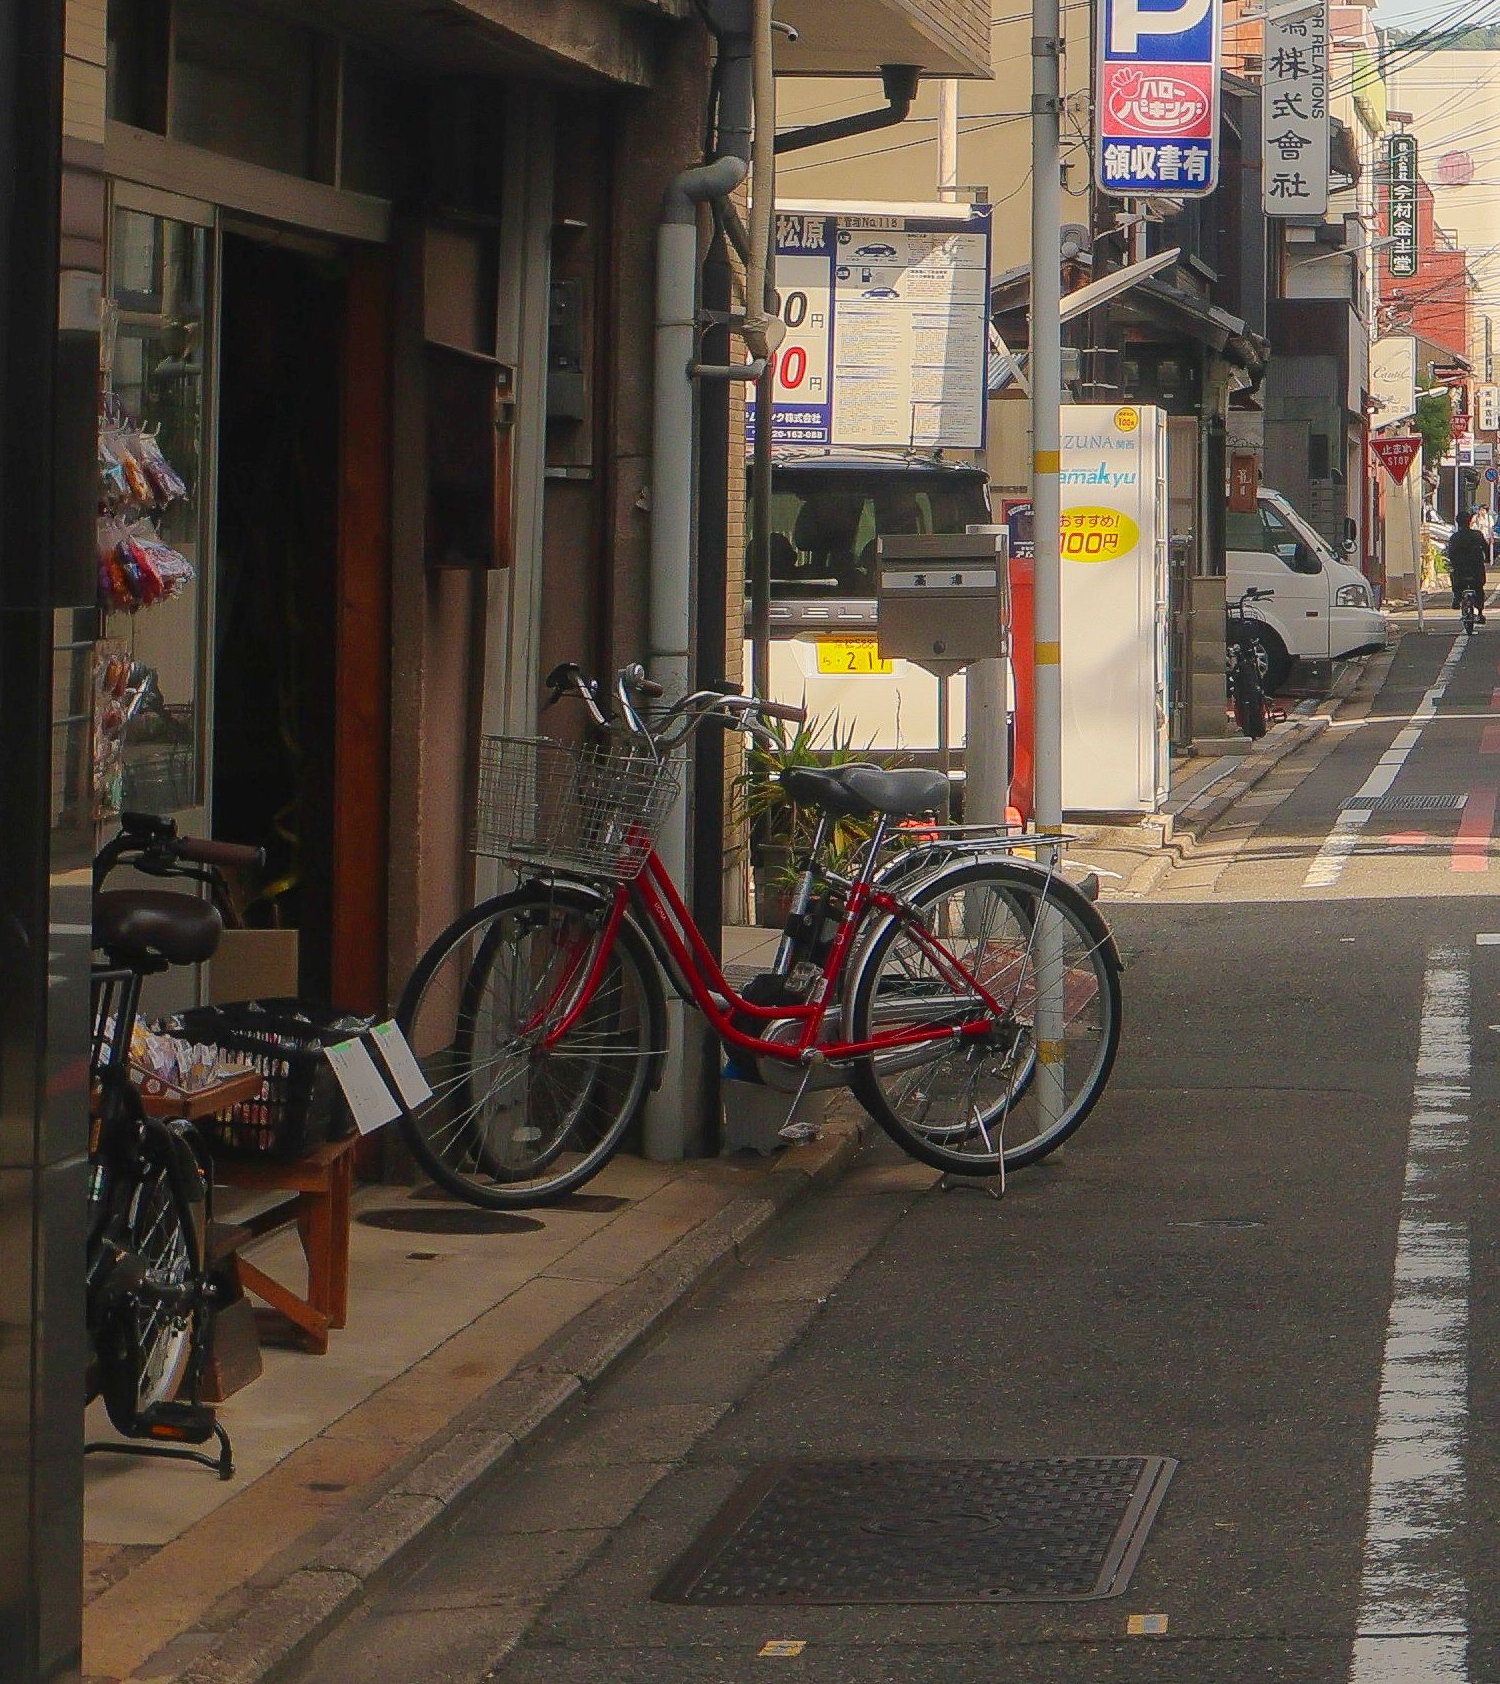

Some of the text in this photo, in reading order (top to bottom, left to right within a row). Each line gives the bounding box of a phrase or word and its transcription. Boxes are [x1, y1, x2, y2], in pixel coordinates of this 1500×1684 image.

[1312, 34, 1325, 119] RELATIONS
[1141, 79, 1186, 100] ハロー
[1103, 143, 1209, 182] 領収書有
[1060, 435, 1114, 450] ZUNA
[1387, 456, 1409, 466] STOP
